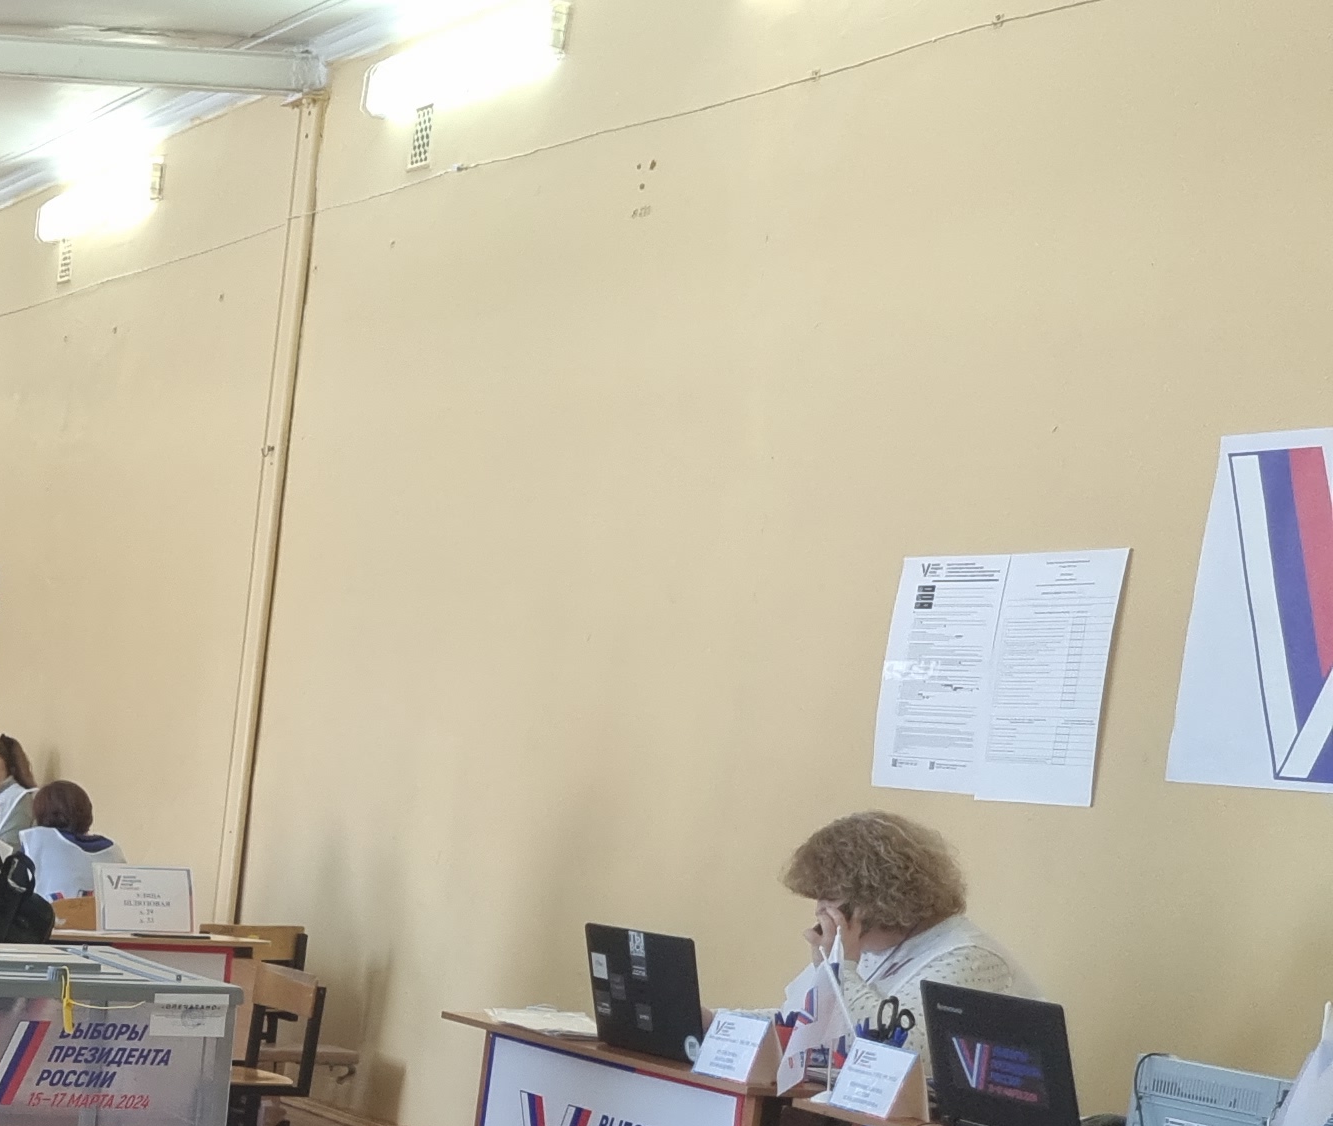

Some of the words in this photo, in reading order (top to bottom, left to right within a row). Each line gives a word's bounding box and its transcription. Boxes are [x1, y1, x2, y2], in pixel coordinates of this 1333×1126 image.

[47, 1045, 172, 1067] ПРЕЗИДЕНТА
[35, 1069, 117, 1088] РОССИИ
[68, 1092, 115, 1109] МАРТА
[114, 1094, 151, 1110] 2024
